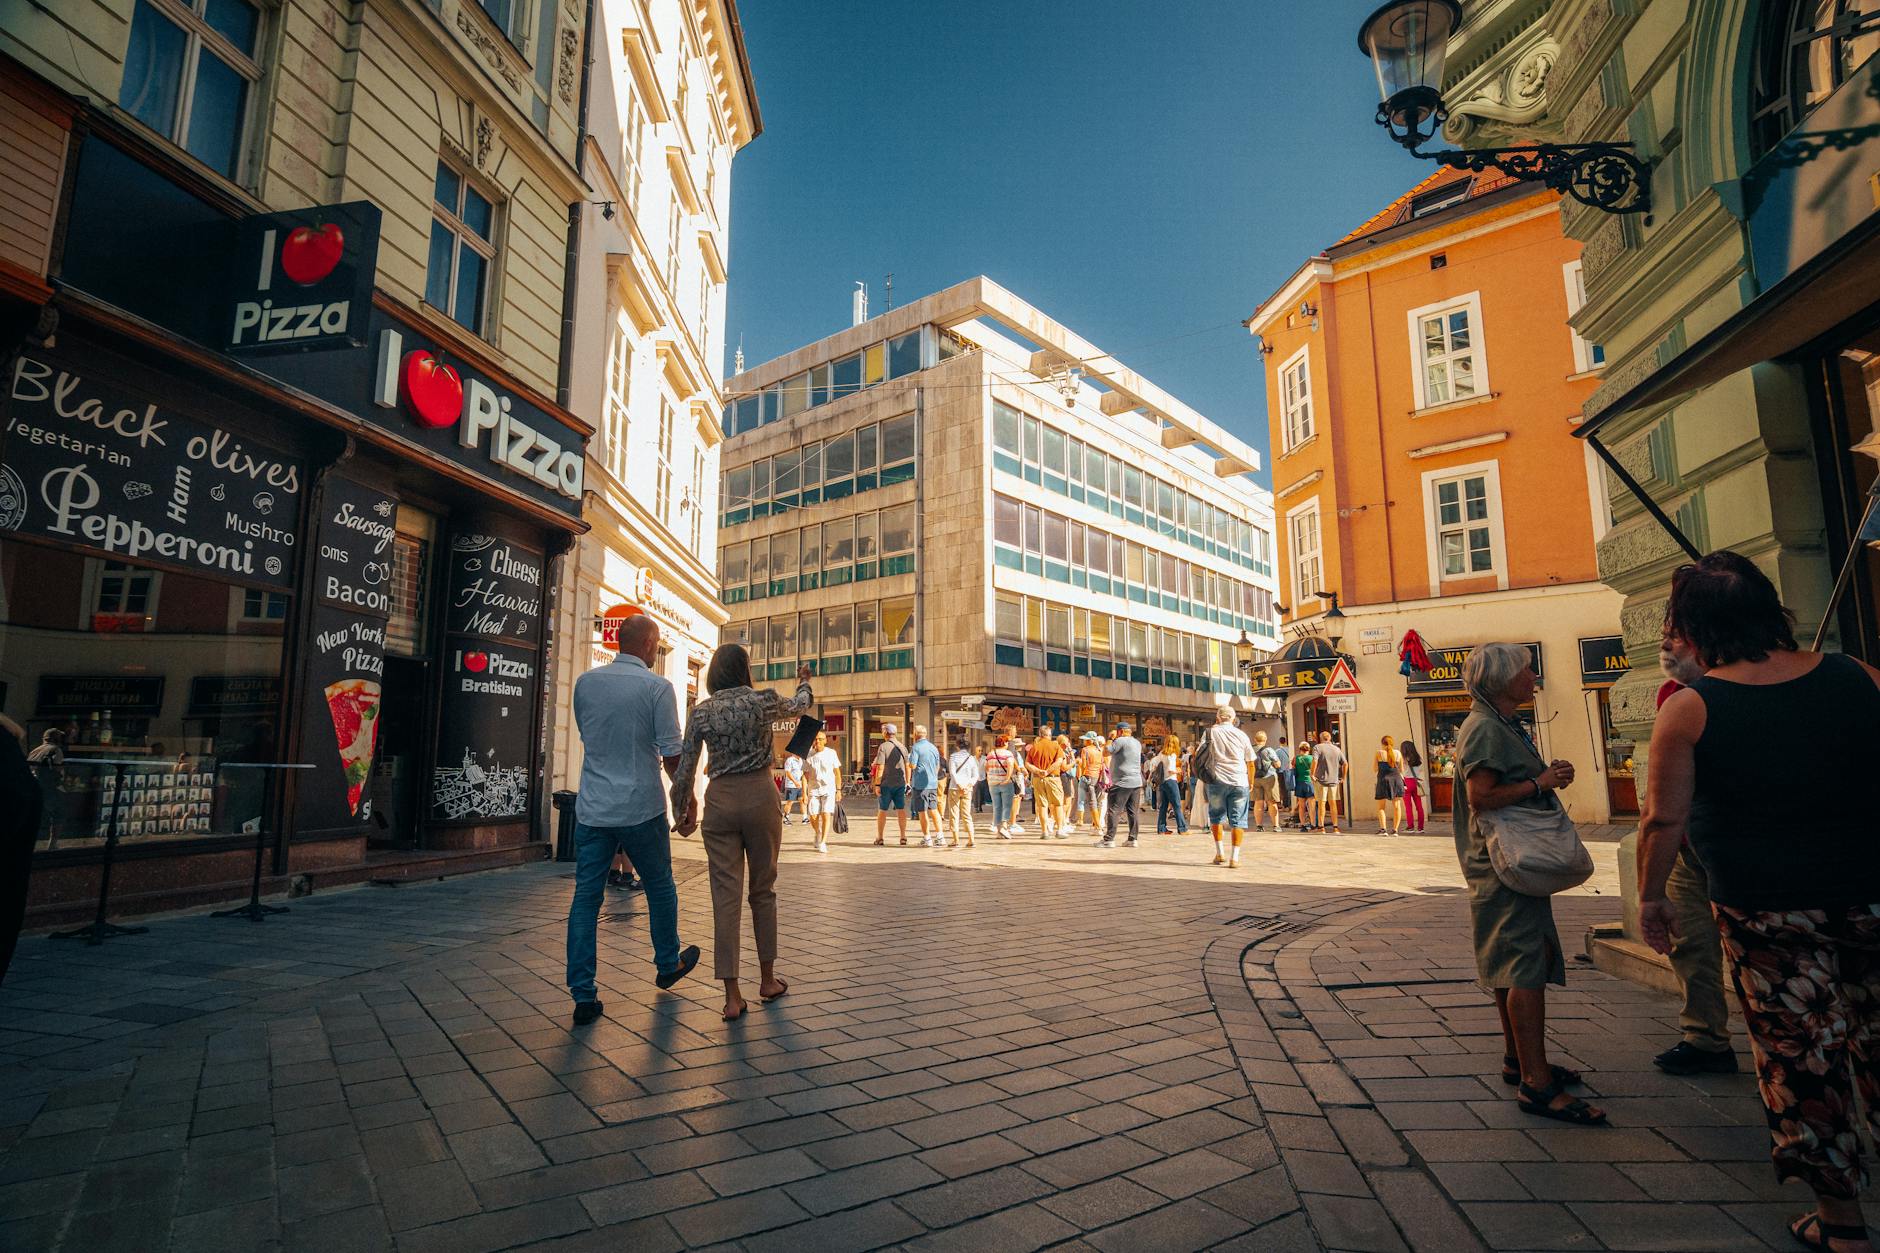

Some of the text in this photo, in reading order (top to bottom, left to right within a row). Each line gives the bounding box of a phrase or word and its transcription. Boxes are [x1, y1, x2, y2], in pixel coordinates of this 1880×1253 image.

[258, 229, 276, 290] I
[232, 299, 349, 344] Pizza
[12, 356, 299, 494] Black olives
[374, 329, 584, 500] I Pizza
[167, 465, 192, 525] Ham
[41, 463, 254, 575] Pepperoni
[225, 512, 294, 546] Mushro
[320, 546, 349, 564] oms
[326, 576, 388, 612] Bacon
[455, 578, 538, 617] Hawaii
[317, 629, 348, 654] New
[351, 622, 382, 645] York
[342, 647, 384, 677] Pizza
[455, 650, 528, 679] I Pizza
[1429, 666, 1458, 680] GOLD
[1604, 655, 1629, 669] JAN
[461, 678, 523, 697] Bratislava
[772, 721, 795, 731] ELATO
